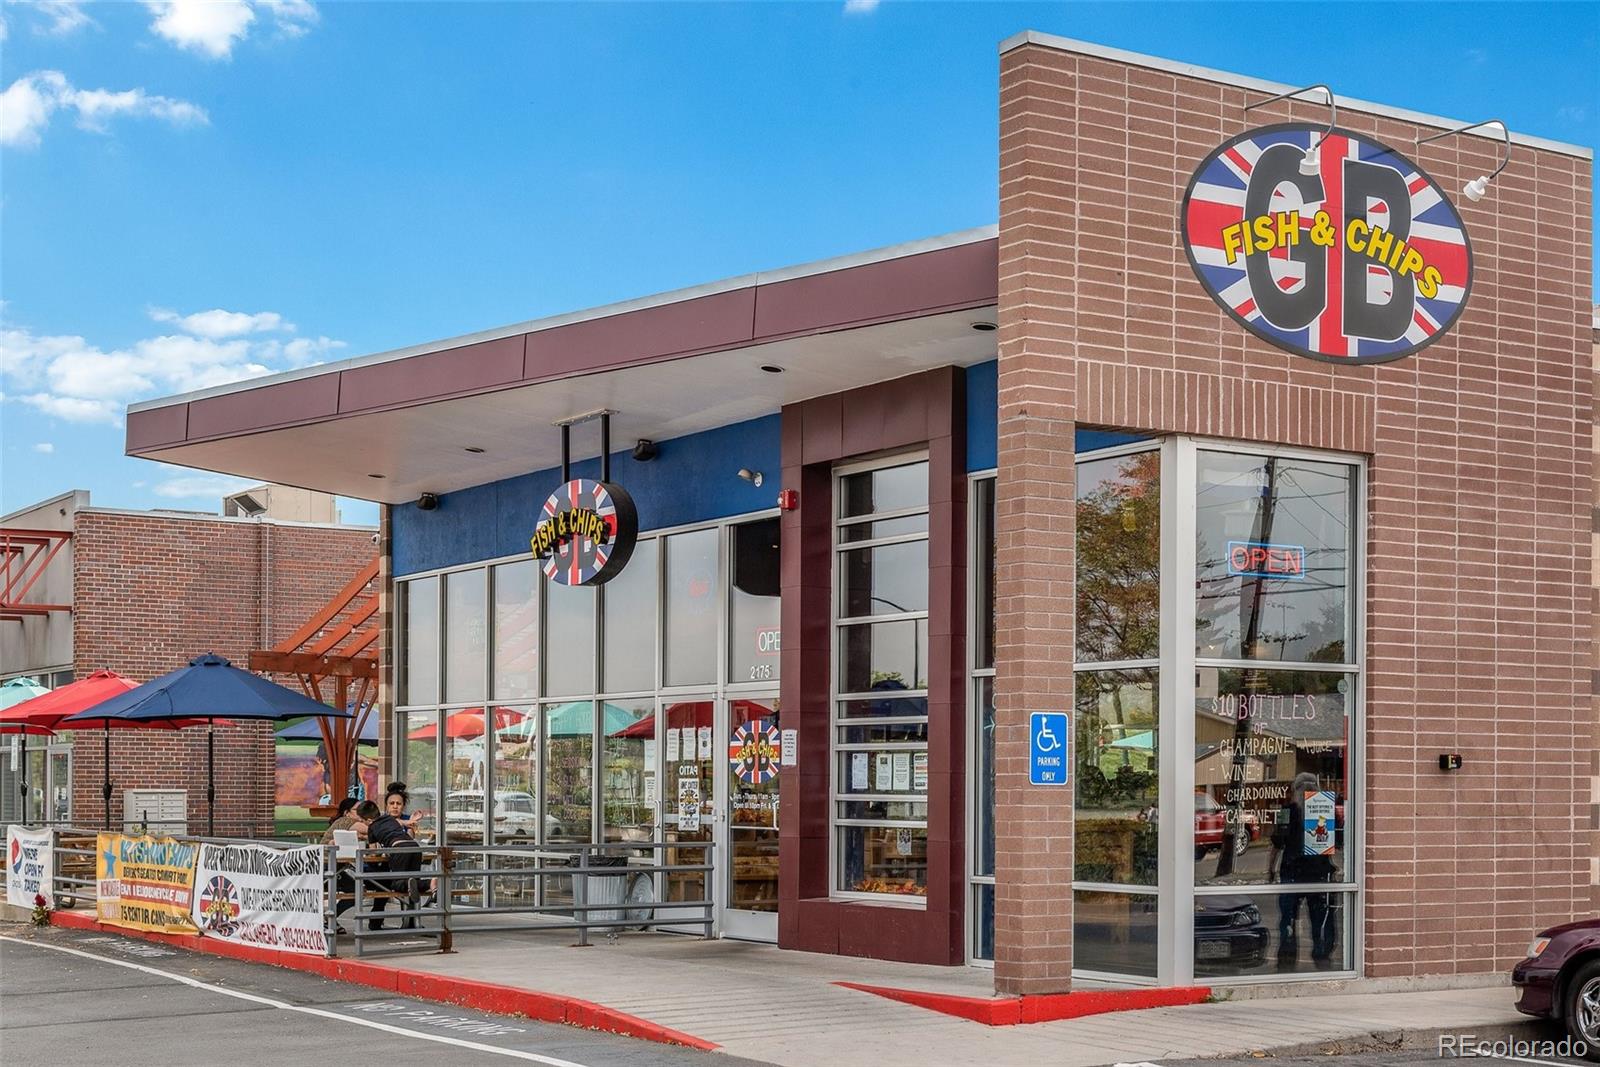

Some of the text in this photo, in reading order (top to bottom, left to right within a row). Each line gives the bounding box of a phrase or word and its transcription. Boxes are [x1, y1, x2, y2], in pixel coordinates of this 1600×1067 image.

[1244, 142, 1416, 343] GB
[1221, 209, 1443, 300] FISH & CHIPS
[530, 508, 604, 559] FISH & CHIPS
[1231, 546, 1300, 573] OPEN
[758, 630, 780, 652] OPE
[750, 664, 770, 679] 2175
[1211, 694, 1316, 720] $10 BOTTLES
[1253, 722, 1268, 735] OF
[757, 742, 779, 763] CHIPS
[1219, 737, 1294, 757] CHAMPAGNE
[1037, 756, 1060, 767] PARKING
[1041, 771, 1056, 781] ONLY
[218, 846, 249, 873] REGULAR
[255, 923, 278, 945] AHEAD
